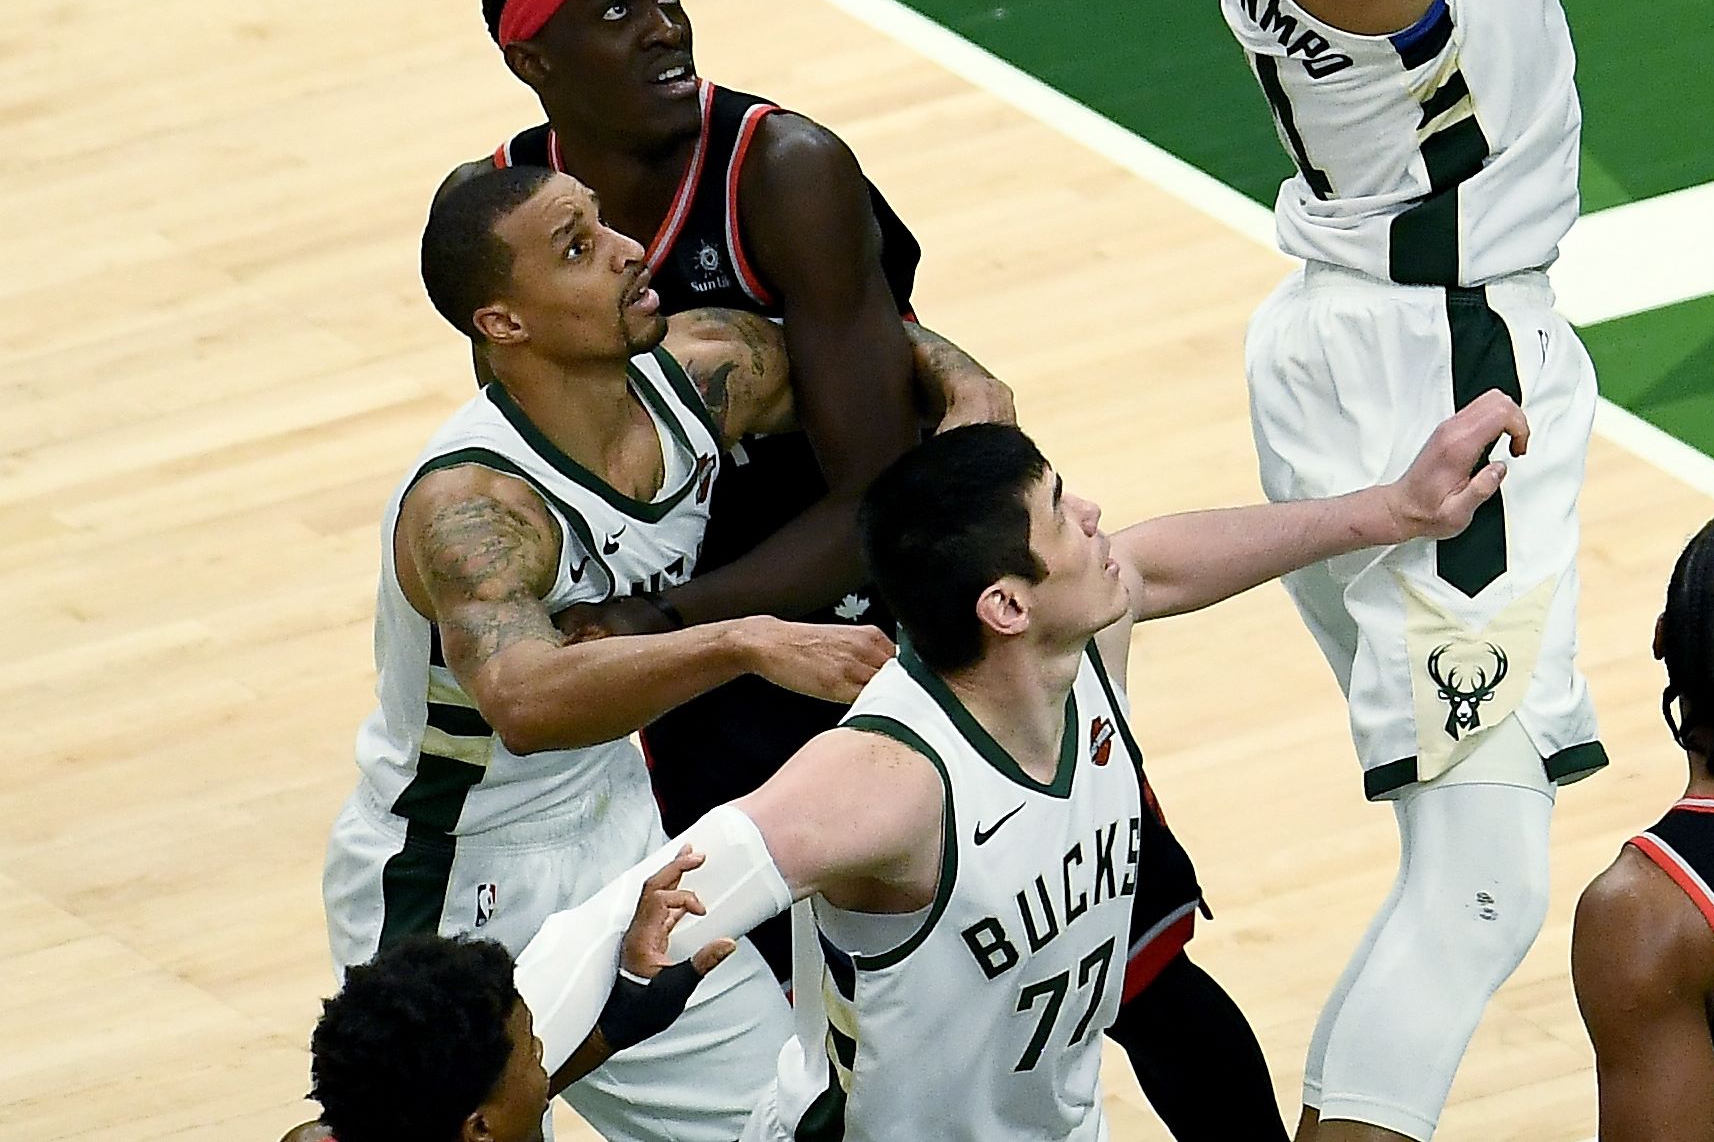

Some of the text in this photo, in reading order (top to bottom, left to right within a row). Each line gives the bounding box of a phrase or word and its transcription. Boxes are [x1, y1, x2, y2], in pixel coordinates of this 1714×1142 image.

[690, 280, 716, 292] Sun
[959, 817, 1140, 981] BUCKS
[1013, 935, 1117, 1074] 77
